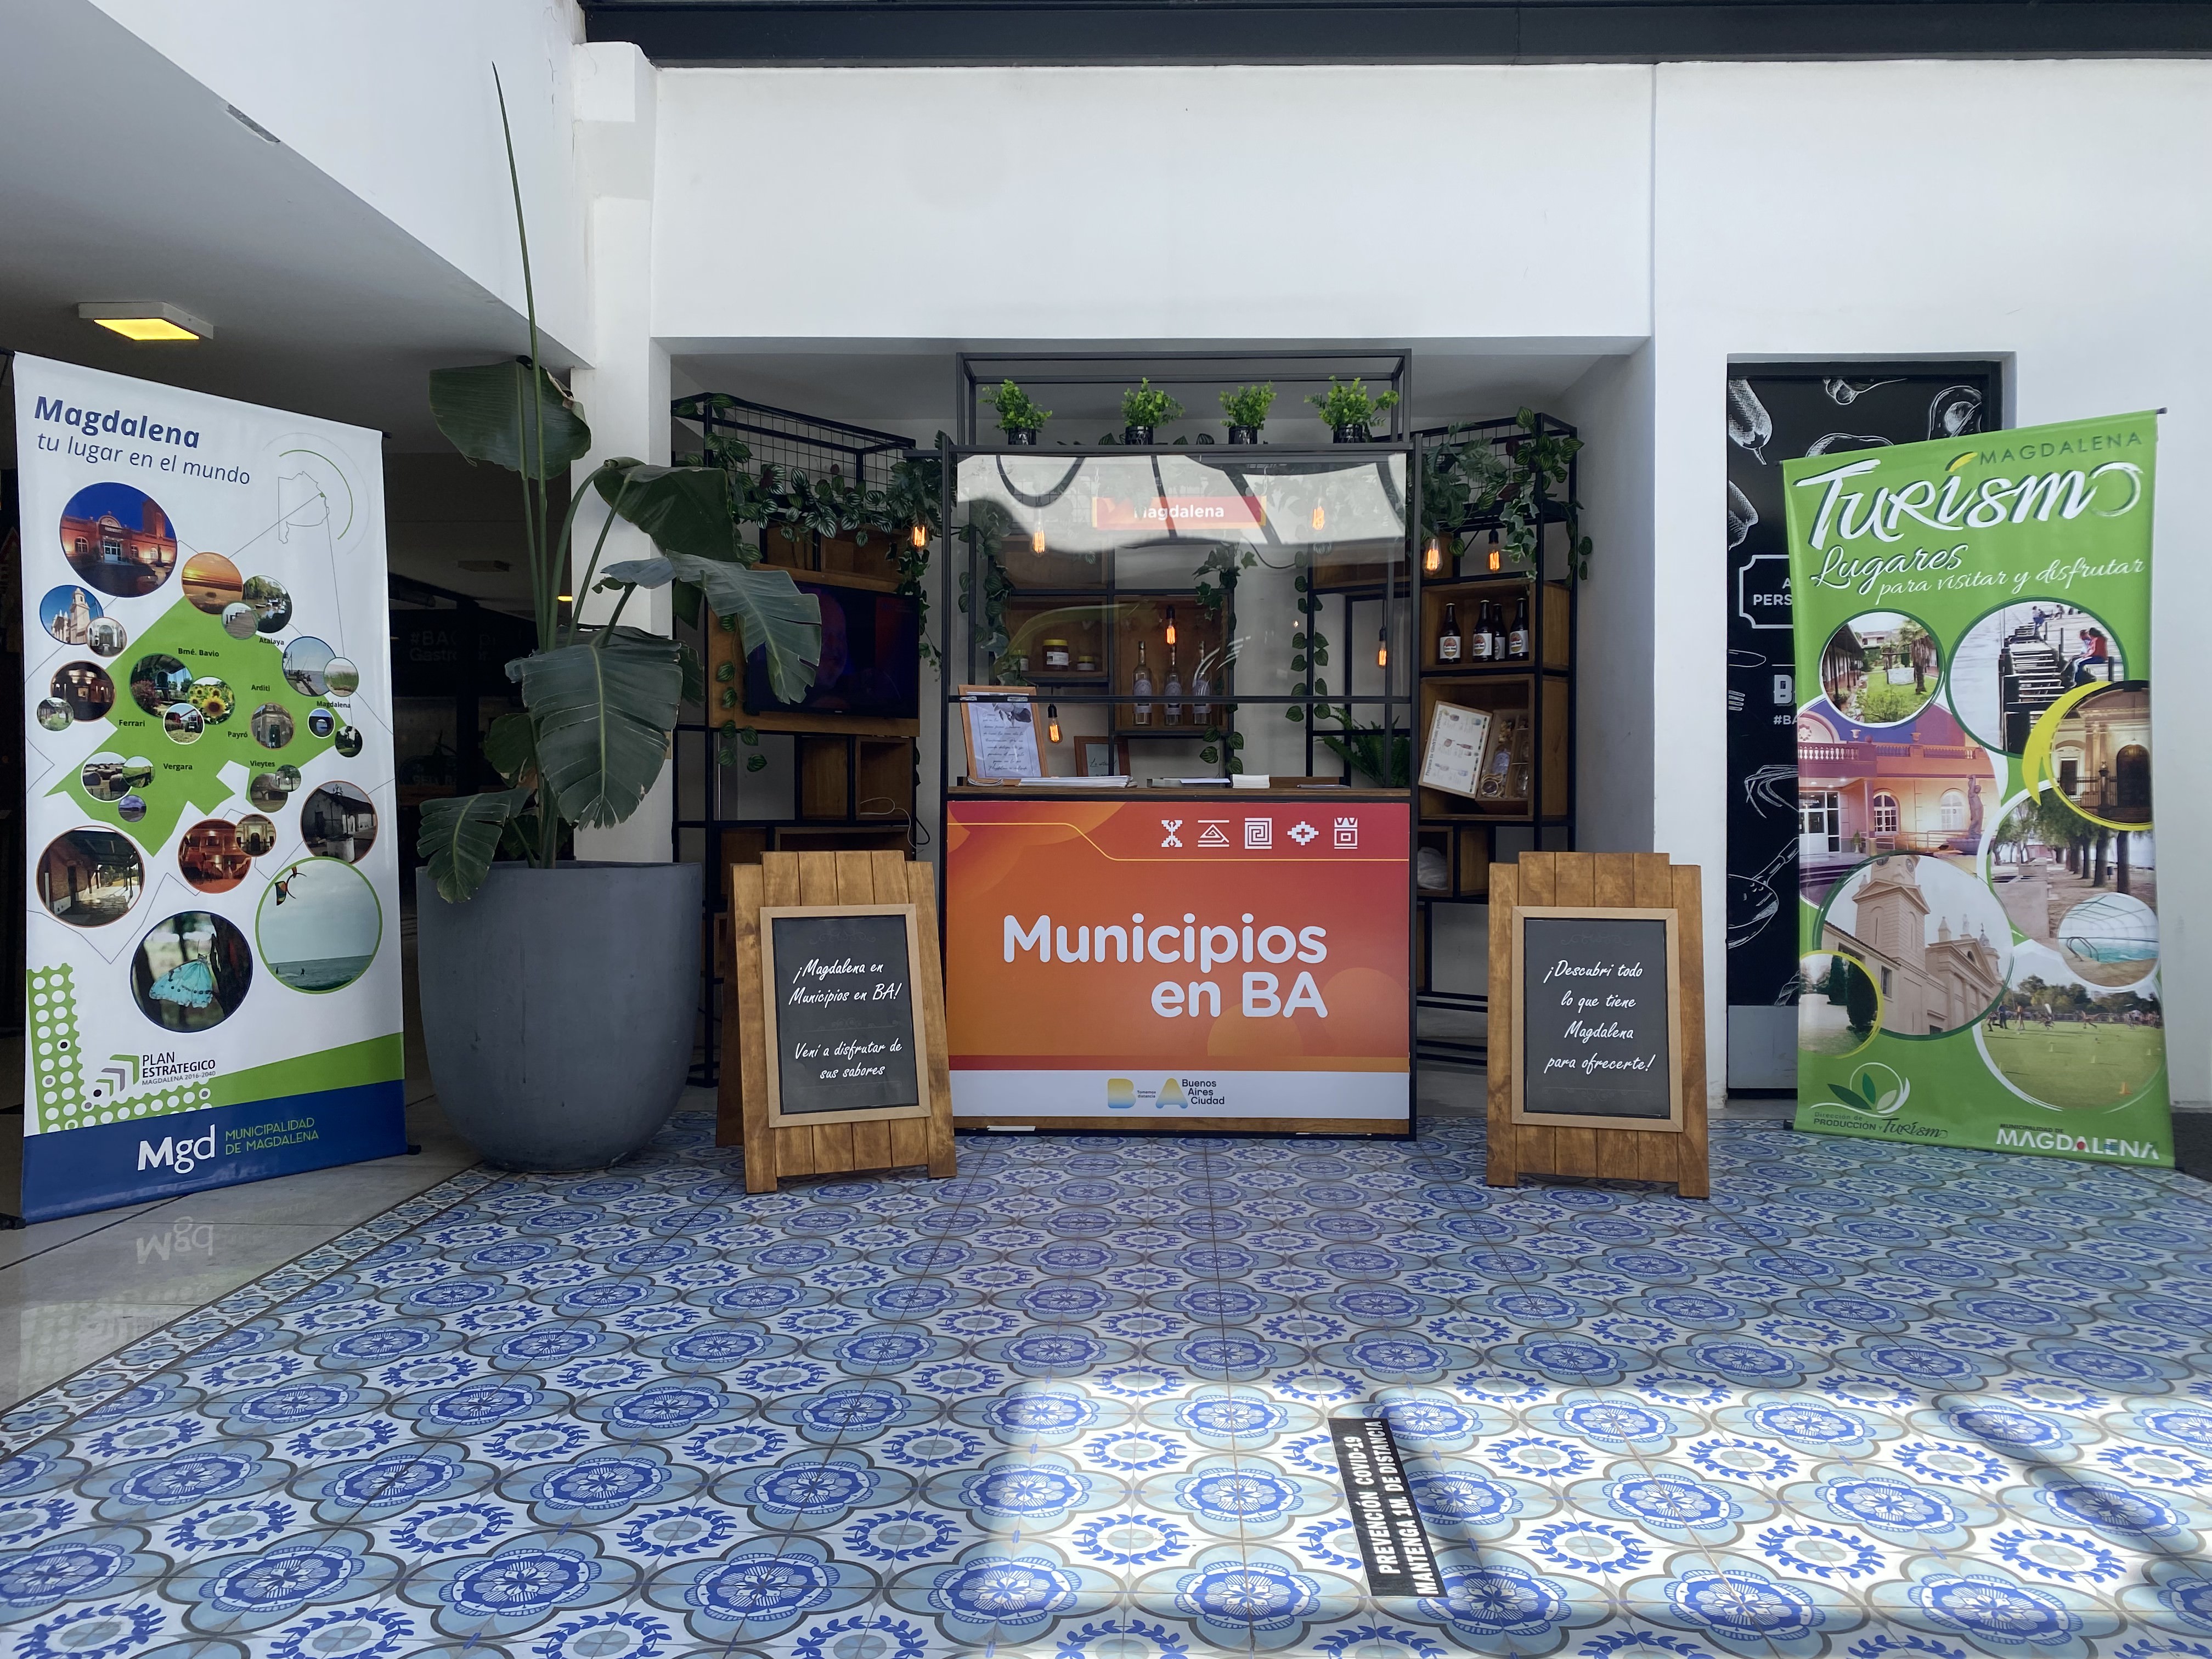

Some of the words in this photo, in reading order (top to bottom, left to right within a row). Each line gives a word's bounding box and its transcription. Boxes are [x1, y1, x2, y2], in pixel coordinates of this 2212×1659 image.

[34, 396, 200, 448] Magdalena
[37, 432, 60, 453] tu
[67, 436, 123, 464] lugar
[129, 450, 153, 469] en
[160, 454, 176, 472] el
[183, 460, 251, 485] mundo
[1979, 431, 2143, 465] MAGDALENA
[1811, 543, 1968, 595] Lugares
[1875, 578, 1932, 605] para
[1937, 571, 2007, 592] visitar
[2013, 573, 2032, 595] y
[2036, 556, 2145, 589] disfrutar
[178, 648, 198, 656] Bmé.
[259, 637, 285, 646] Atalaya
[316, 701, 351, 709] Magdalena
[228, 731, 248, 739] Payró
[250, 760, 275, 768] Vieytes
[1003, 912, 1328, 973] Municipios
[793, 957, 866, 984] ¡Magdalena
[870, 962, 884, 973] en
[1618, 962, 1644, 977] todo
[788, 986, 850, 1008] Municipios
[854, 992, 867, 1001] en
[872, 983, 902, 1001] BA!
[1151, 980, 1221, 1018] en
[1242, 971, 1329, 1018] BA
[1560, 990, 1573, 1006] lo
[1578, 997, 1600, 1013] que
[1606, 994, 1637, 1008] tiene
[1564, 1020, 1634, 1043] Magdalena
[143, 1051, 175, 1066] PLAN
[794, 1042, 821, 1059] Vení
[823, 1048, 830, 1057] a
[834, 1039, 886, 1060] disfrutar
[889, 1038, 902, 1052] de
[143, 1059, 216, 1078] ESTRATEGICO
[820, 1068, 839, 1080] sus
[843, 1062, 885, 1078] sabores
[1544, 1056, 1576, 1074] para
[1581, 1052, 1656, 1075] ofrecerte!
[142, 1075, 184, 1086] MAGDALENA
[184, 1070, 216, 1080] 2016-2040
[1182, 1079, 1217, 1087] Buenos
[1188, 1088, 1214, 1096] Aires
[1190, 1096, 1225, 1105] Ciudad
[1814, 1111, 1852, 1120] Dirección
[1814, 1118, 1876, 1131] PRODUCCIÓN
[225, 1118, 315, 1142] MUNICIPALIDAD
[2000, 1124, 2053, 1133] MUNICIPALIDAD
[137, 1124, 216, 1174] Mgd
[225, 1142, 242, 1155] DE
[246, 1130, 319, 1152] MAGDALENA
[1996, 1128, 2160, 1160] MAGDALENA
[1364, 1421, 1400, 1475] DISTANCIA
[1344, 1436, 1374, 1486] COVID-19
[1381, 1476, 1405, 1493] DE
[1355, 1491, 1401, 1575] PREVENCIÓN
[1396, 1520, 1440, 1595] MANTENGA
